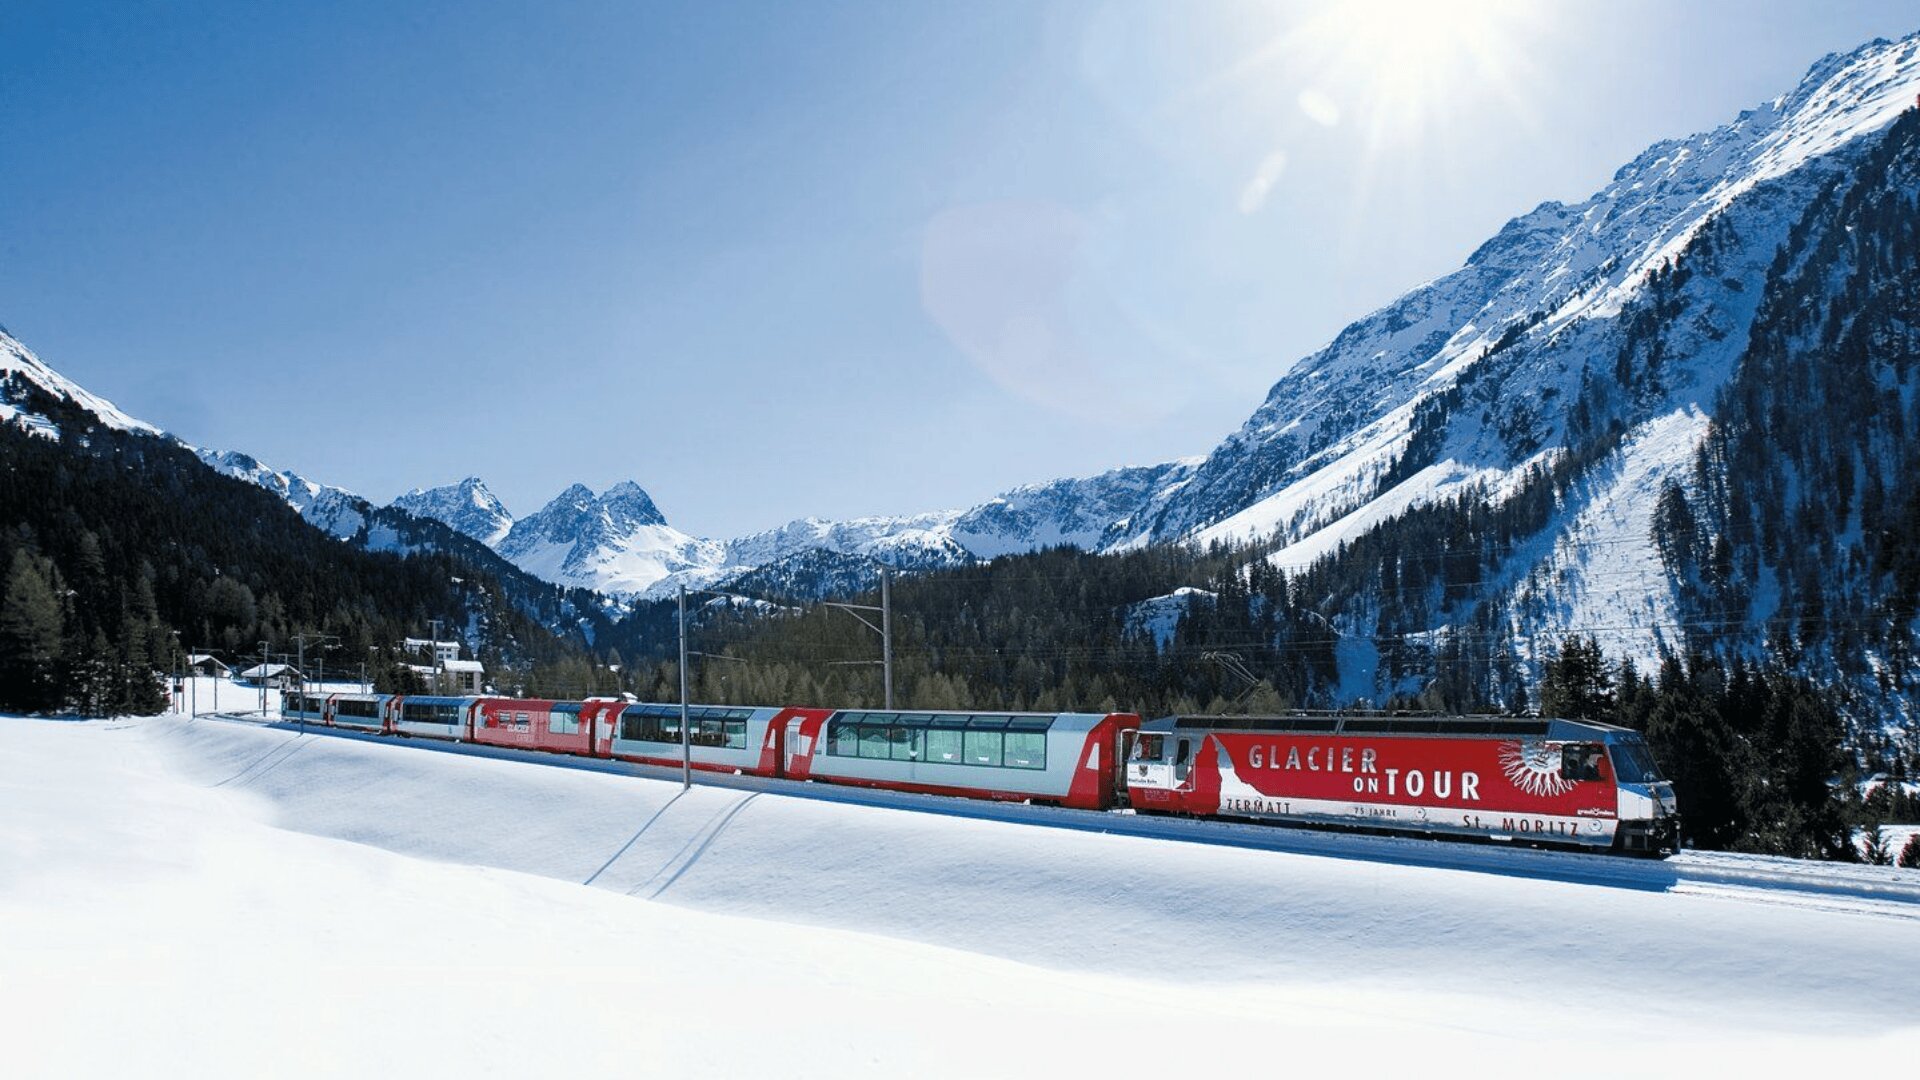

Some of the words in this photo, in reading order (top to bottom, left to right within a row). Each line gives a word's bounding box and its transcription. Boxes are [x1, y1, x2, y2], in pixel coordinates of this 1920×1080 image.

[1249, 745, 1376, 773] GLACIER
[1353, 777, 1378, 793] ON
[1385, 768, 1480, 800] TOUR
[1226, 798, 1291, 815] ZERMATT
[1354, 807, 1364, 815] 75
[1369, 808, 1397, 817] JAHRE
[1463, 815, 1489, 830] St.
[1502, 817, 1579, 837] MORITZ
